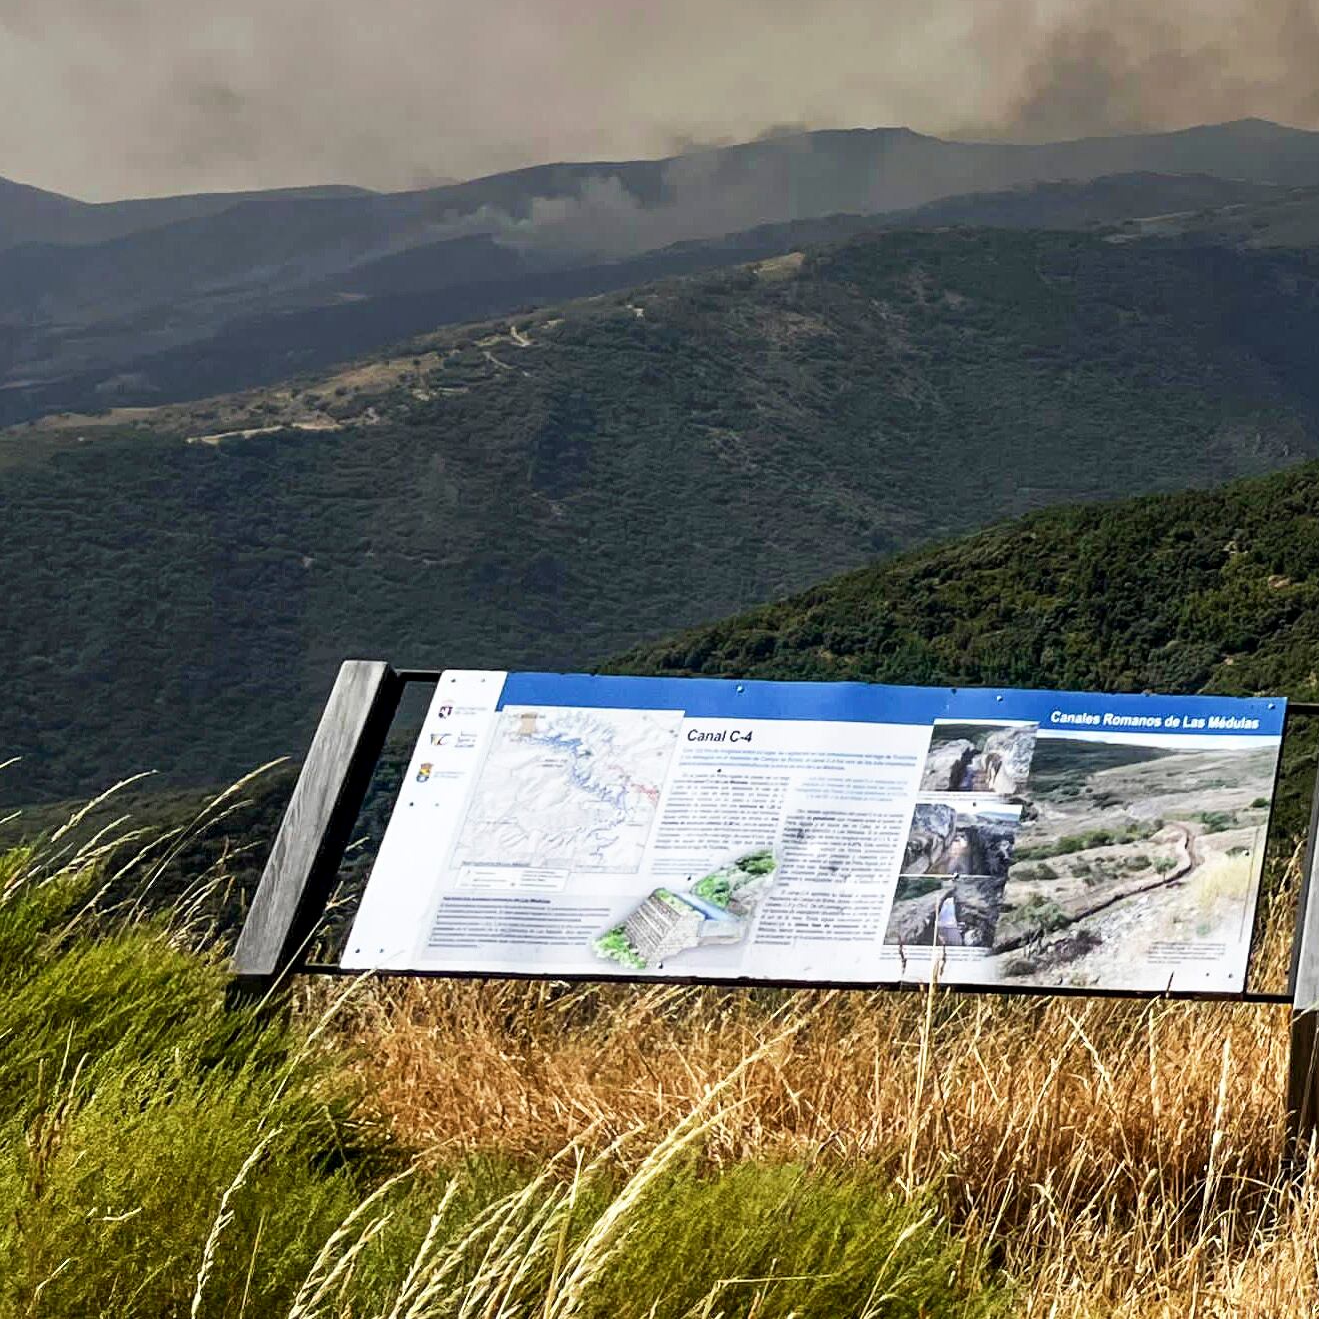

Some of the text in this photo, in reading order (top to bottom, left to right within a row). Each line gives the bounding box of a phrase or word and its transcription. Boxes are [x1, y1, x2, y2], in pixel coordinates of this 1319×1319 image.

[1050, 710, 1260, 730] Canales Romanos de Las Médulas
[687, 728, 753, 743] Canal C-4
